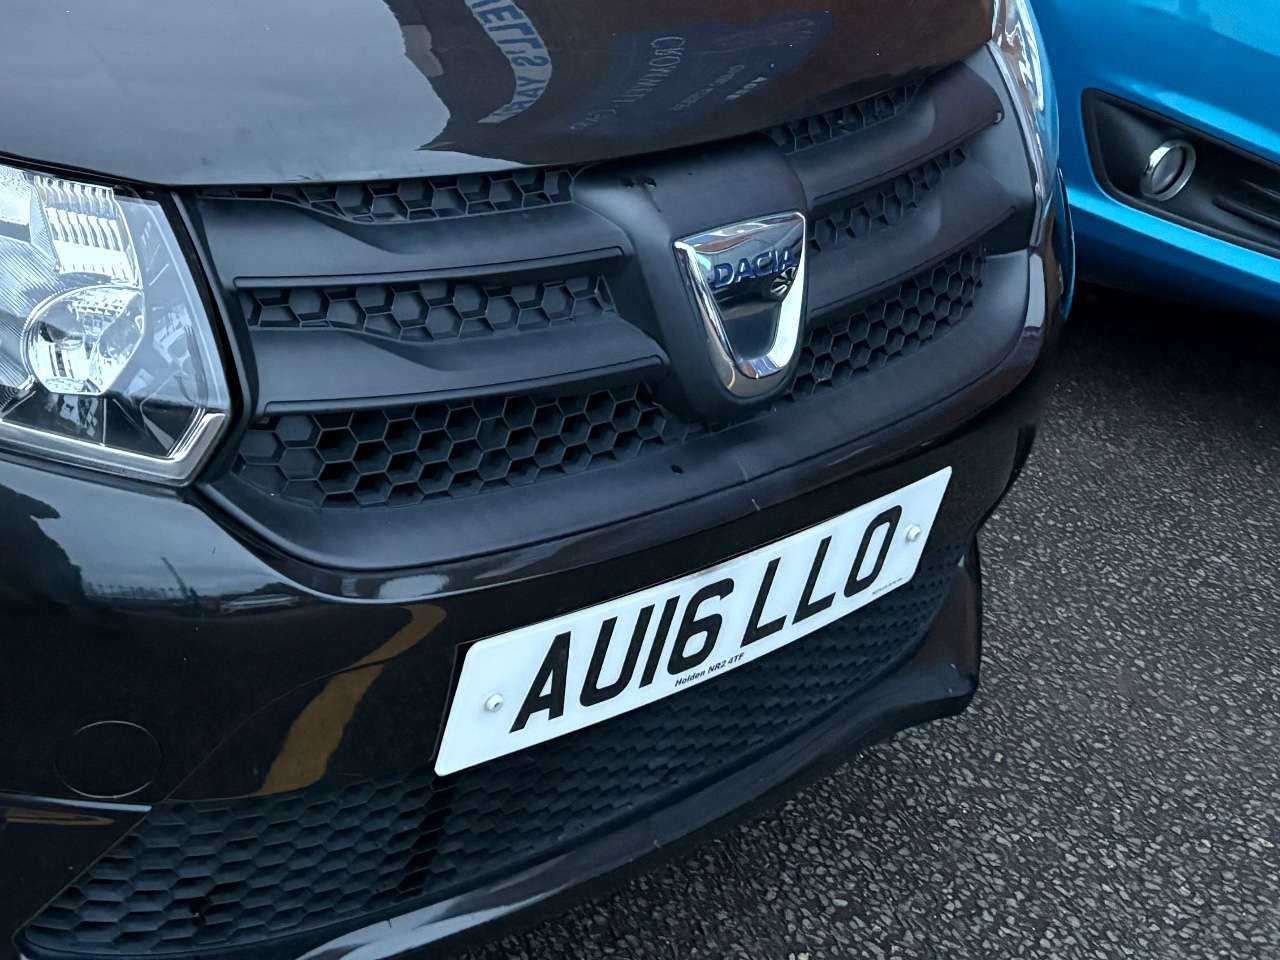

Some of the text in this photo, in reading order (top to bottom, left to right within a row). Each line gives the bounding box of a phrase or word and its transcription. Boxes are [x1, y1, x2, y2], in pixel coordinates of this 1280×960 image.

[713, 246, 798, 289] DACIA
[509, 505, 903, 734] AU16 LLO
[675, 670, 706, 687] Holden
[707, 660, 727, 674] NR2
